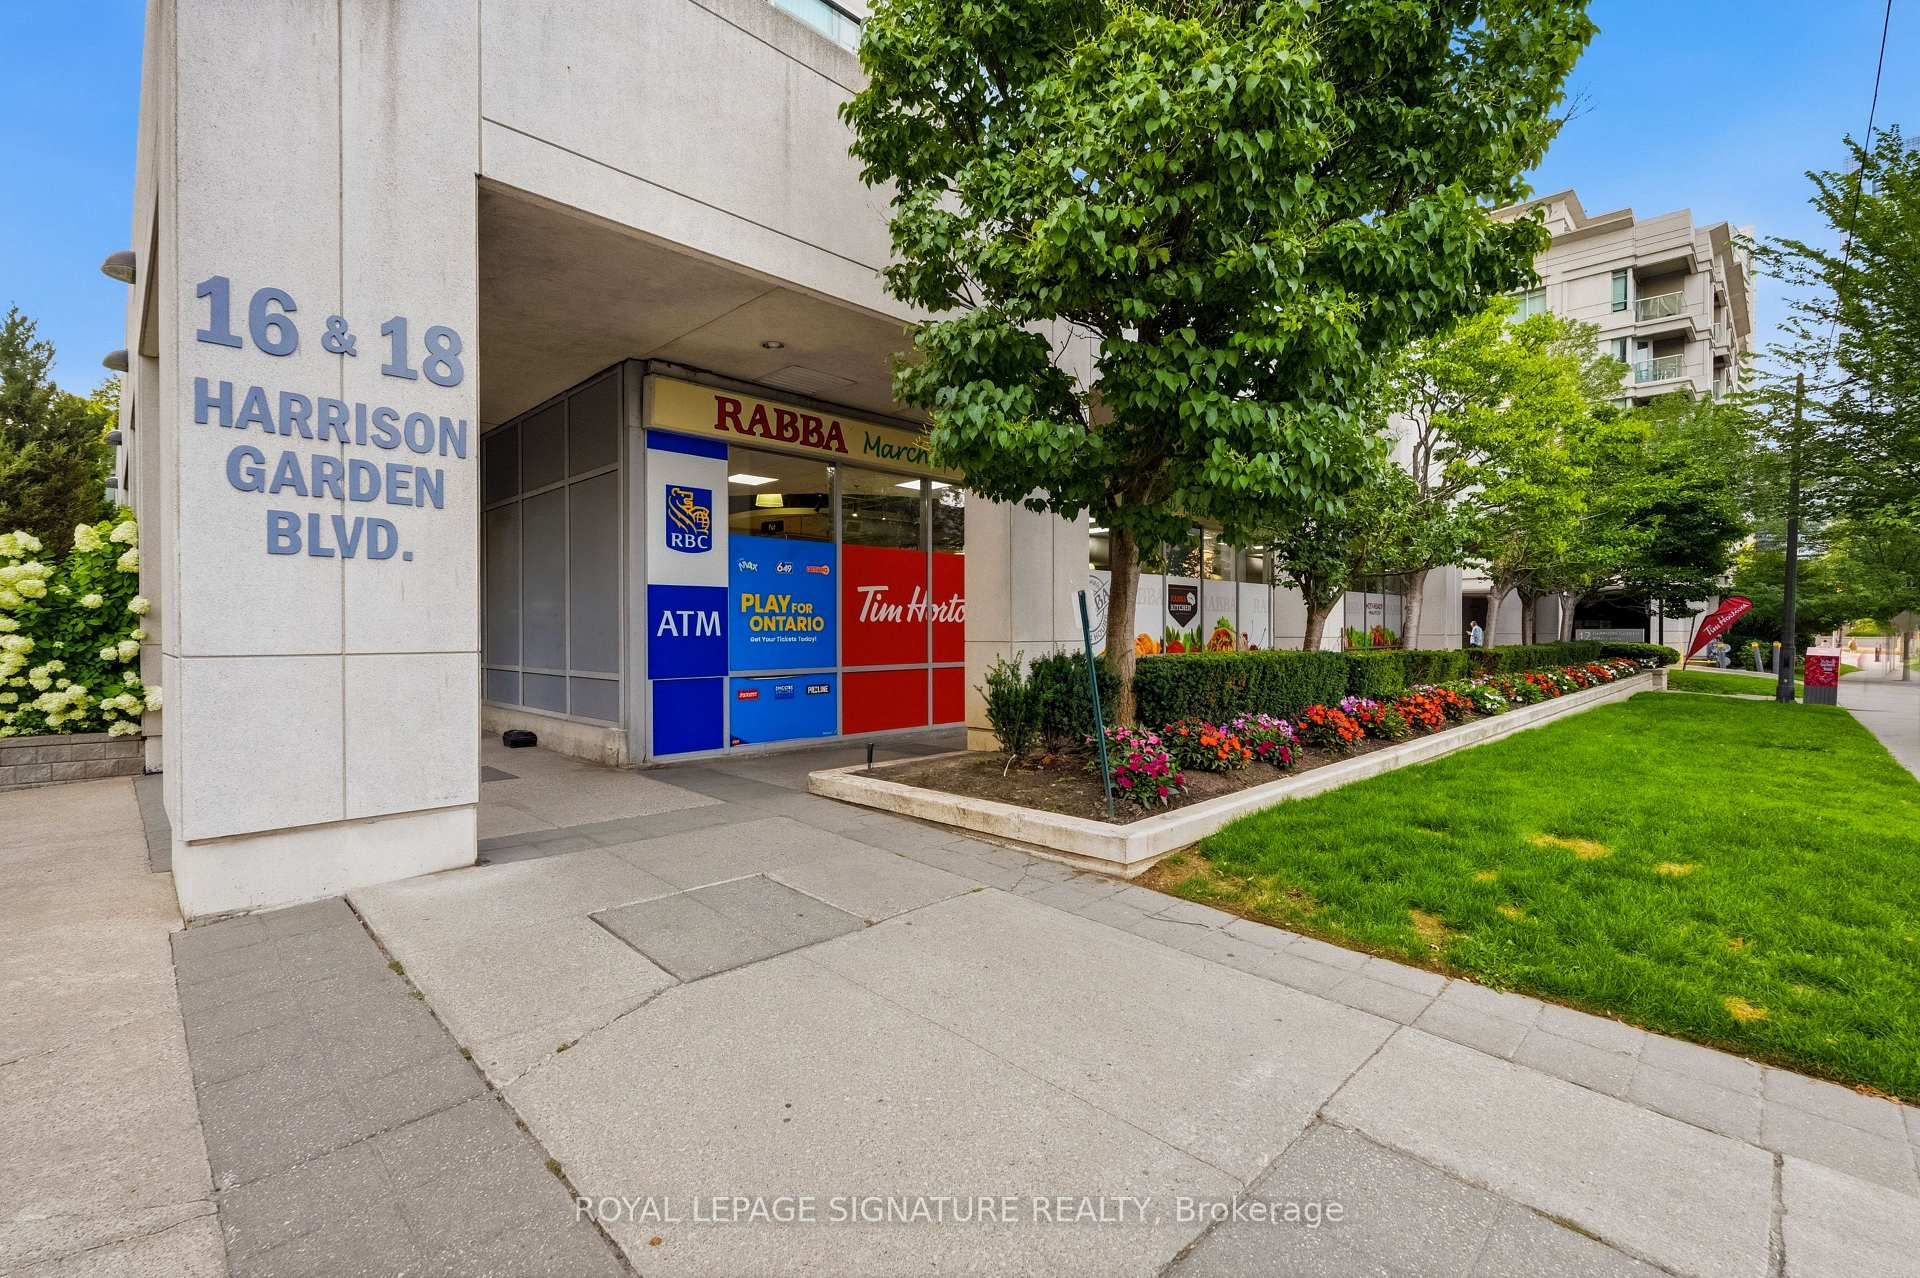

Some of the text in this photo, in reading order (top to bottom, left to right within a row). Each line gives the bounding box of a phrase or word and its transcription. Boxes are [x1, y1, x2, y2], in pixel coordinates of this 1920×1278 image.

[196, 275, 464, 387] 16 & 18
[194, 377, 467, 459] HARRISON
[714, 395, 849, 454] RABBA
[226, 445, 445, 509] GARDEN
[266, 509, 413, 562] BLVD.
[671, 532, 708, 549] RBC
[741, 593, 813, 614] PLAY FOR
[857, 585, 903, 623] Tim
[656, 610, 721, 637] ATM
[749, 616, 824, 632] ONTARIO
[798, 636, 817, 644] Today!
